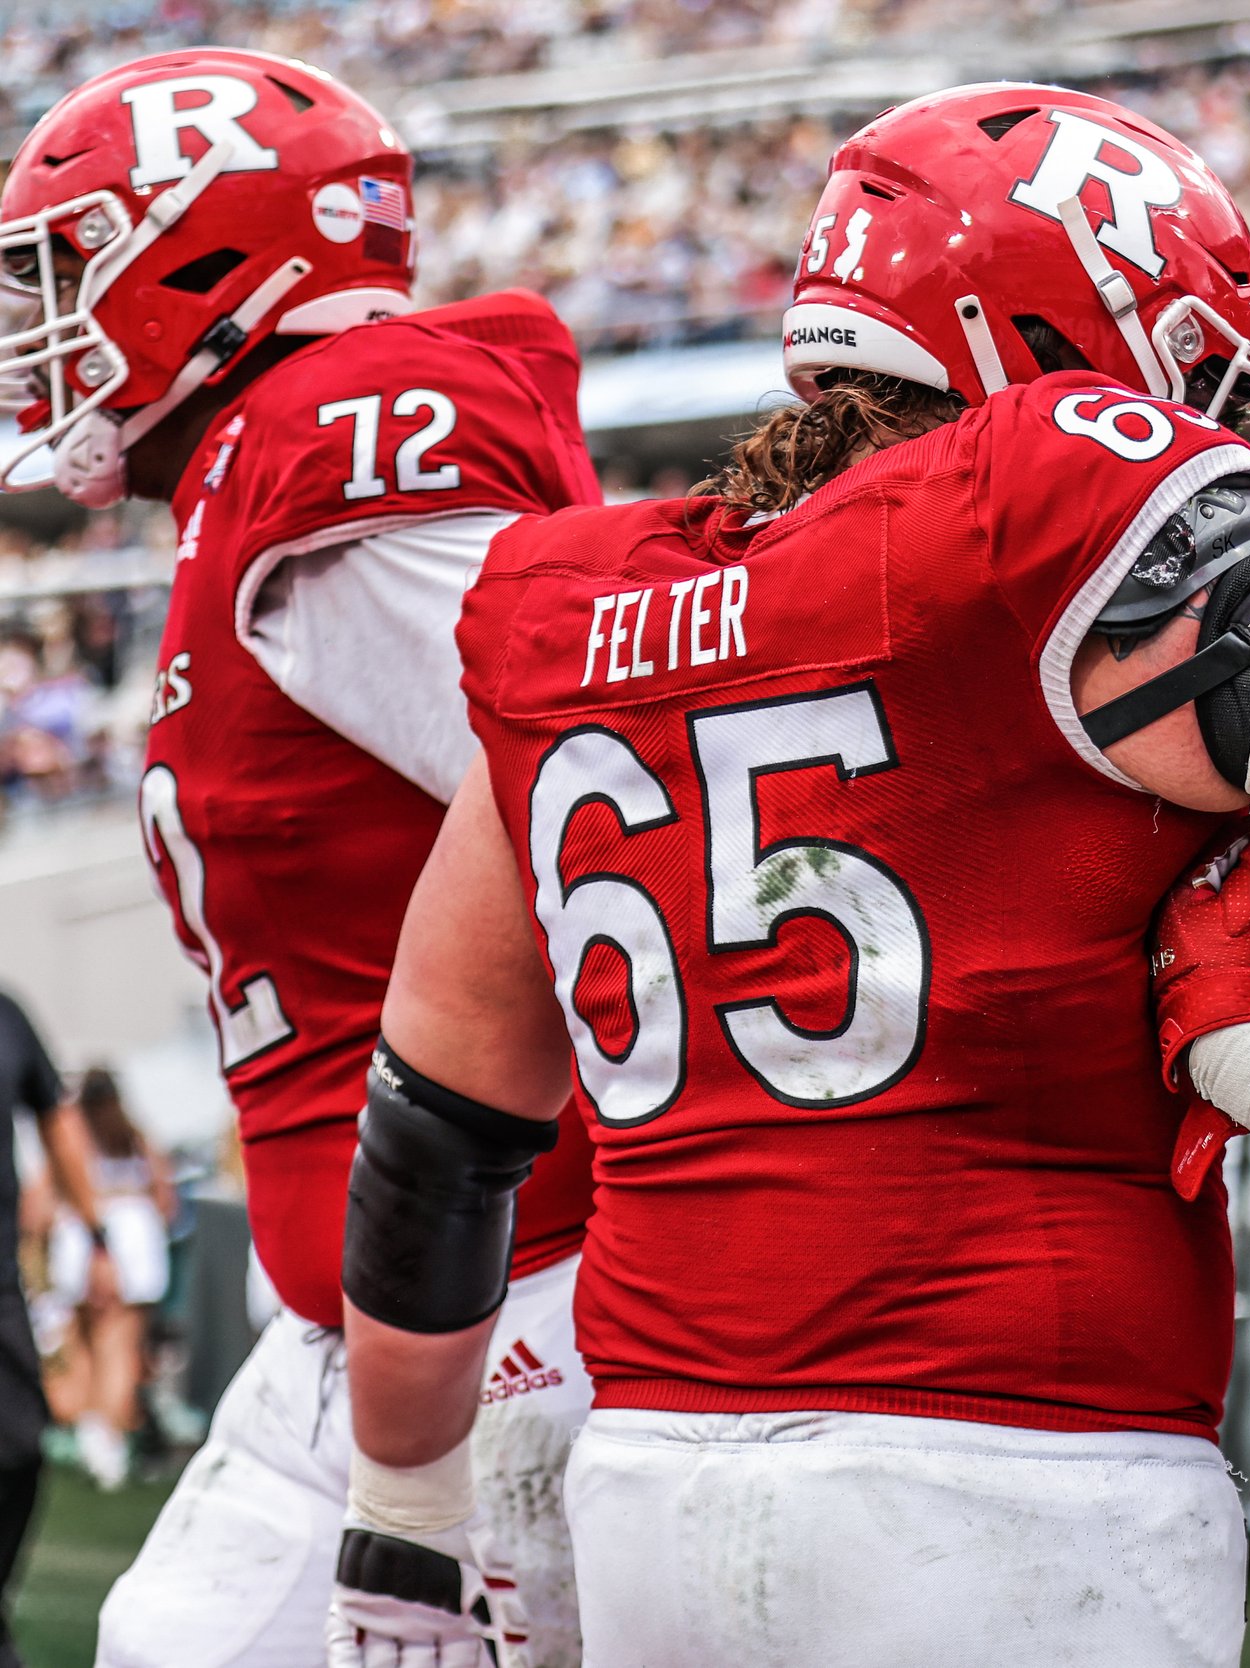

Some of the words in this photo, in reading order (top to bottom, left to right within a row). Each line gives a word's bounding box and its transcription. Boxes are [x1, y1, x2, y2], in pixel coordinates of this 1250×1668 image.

[121, 74, 279, 189] R
[797, 213, 838, 279] 5
[1008, 108, 1182, 283] R
[318, 388, 463, 500] 72
[1052, 386, 1221, 463] 6
[1211, 532, 1236, 560] SK
[580, 565, 749, 688] FELTER
[529, 678, 932, 1129] 65
[480, 1369, 563, 1405] adidas
